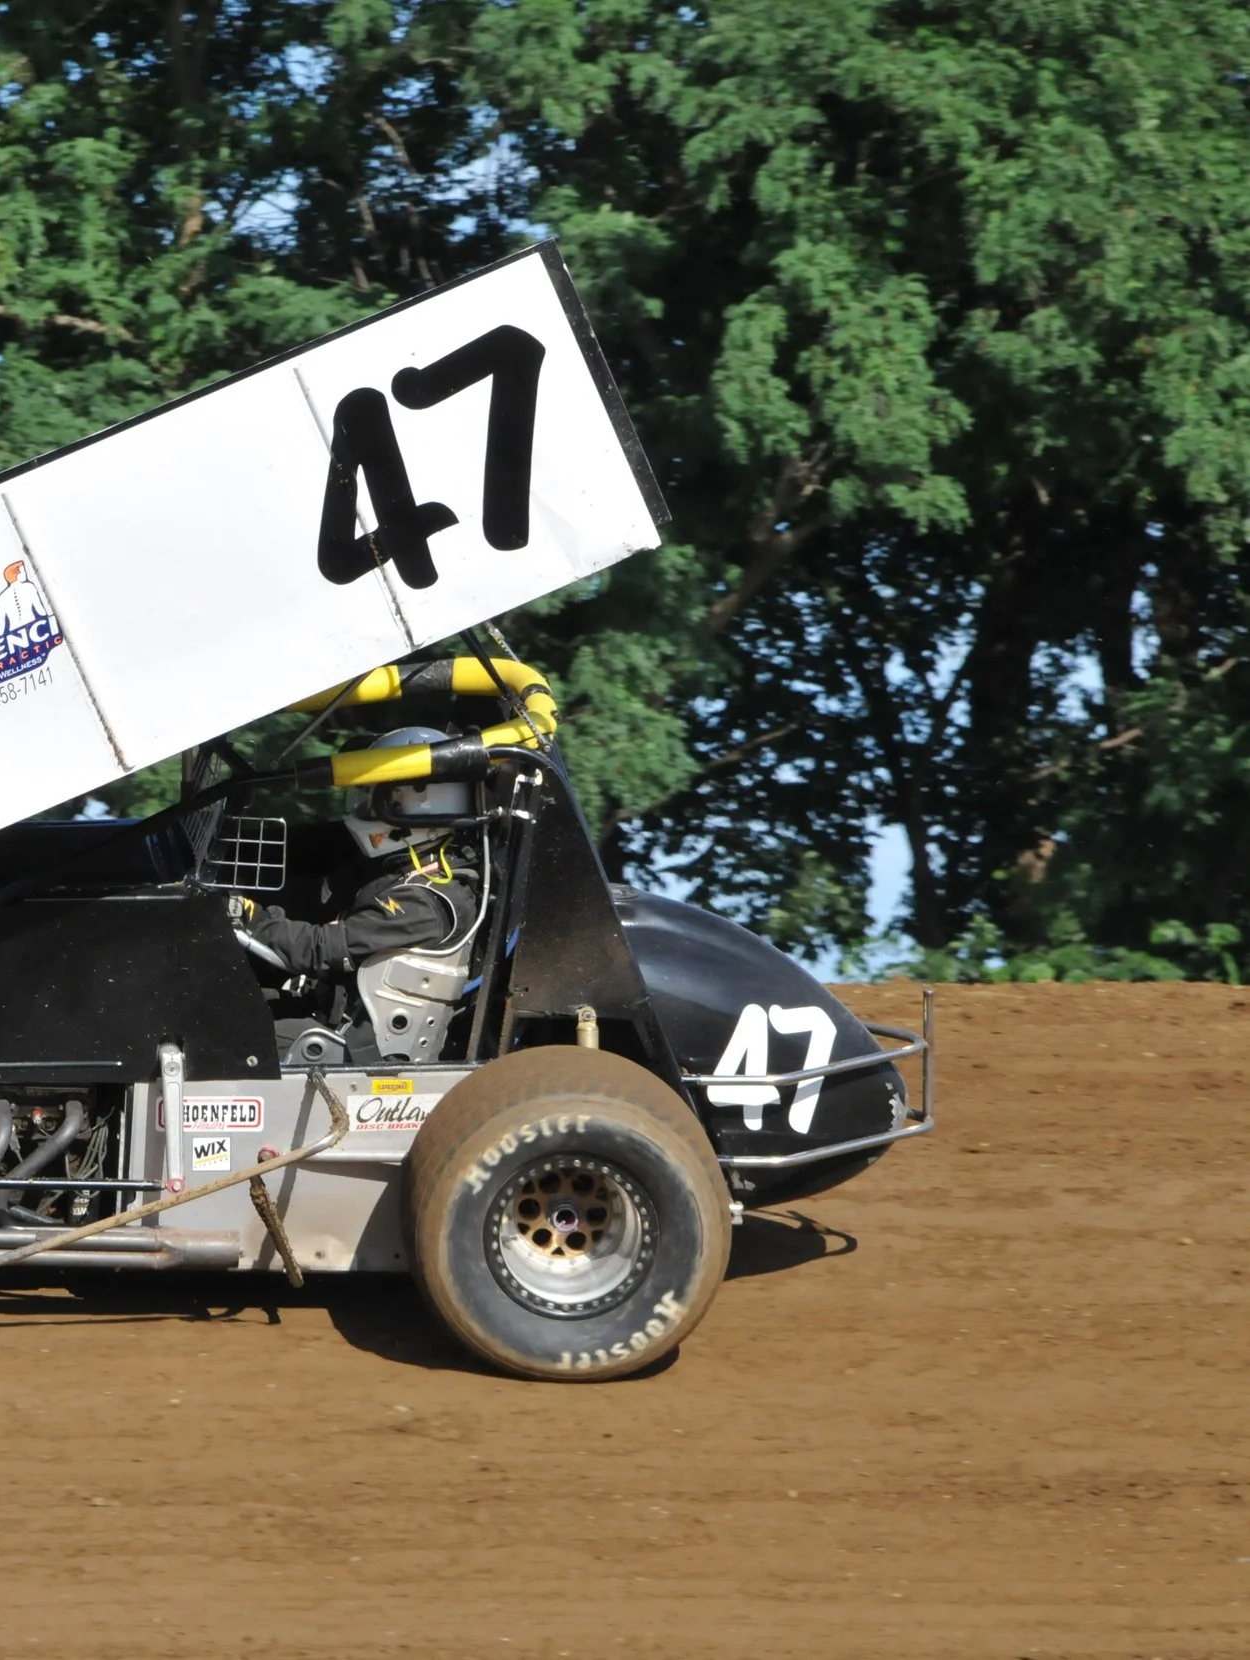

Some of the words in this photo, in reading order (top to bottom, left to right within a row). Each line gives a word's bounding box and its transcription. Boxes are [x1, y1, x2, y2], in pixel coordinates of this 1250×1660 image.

[317, 324, 546, 590] 47
[707, 1003, 837, 1135] 47
[182, 1105, 256, 1122] HOENFELD
[387, 1122, 420, 1130] BRAK
[194, 1139, 228, 1159] WIX
